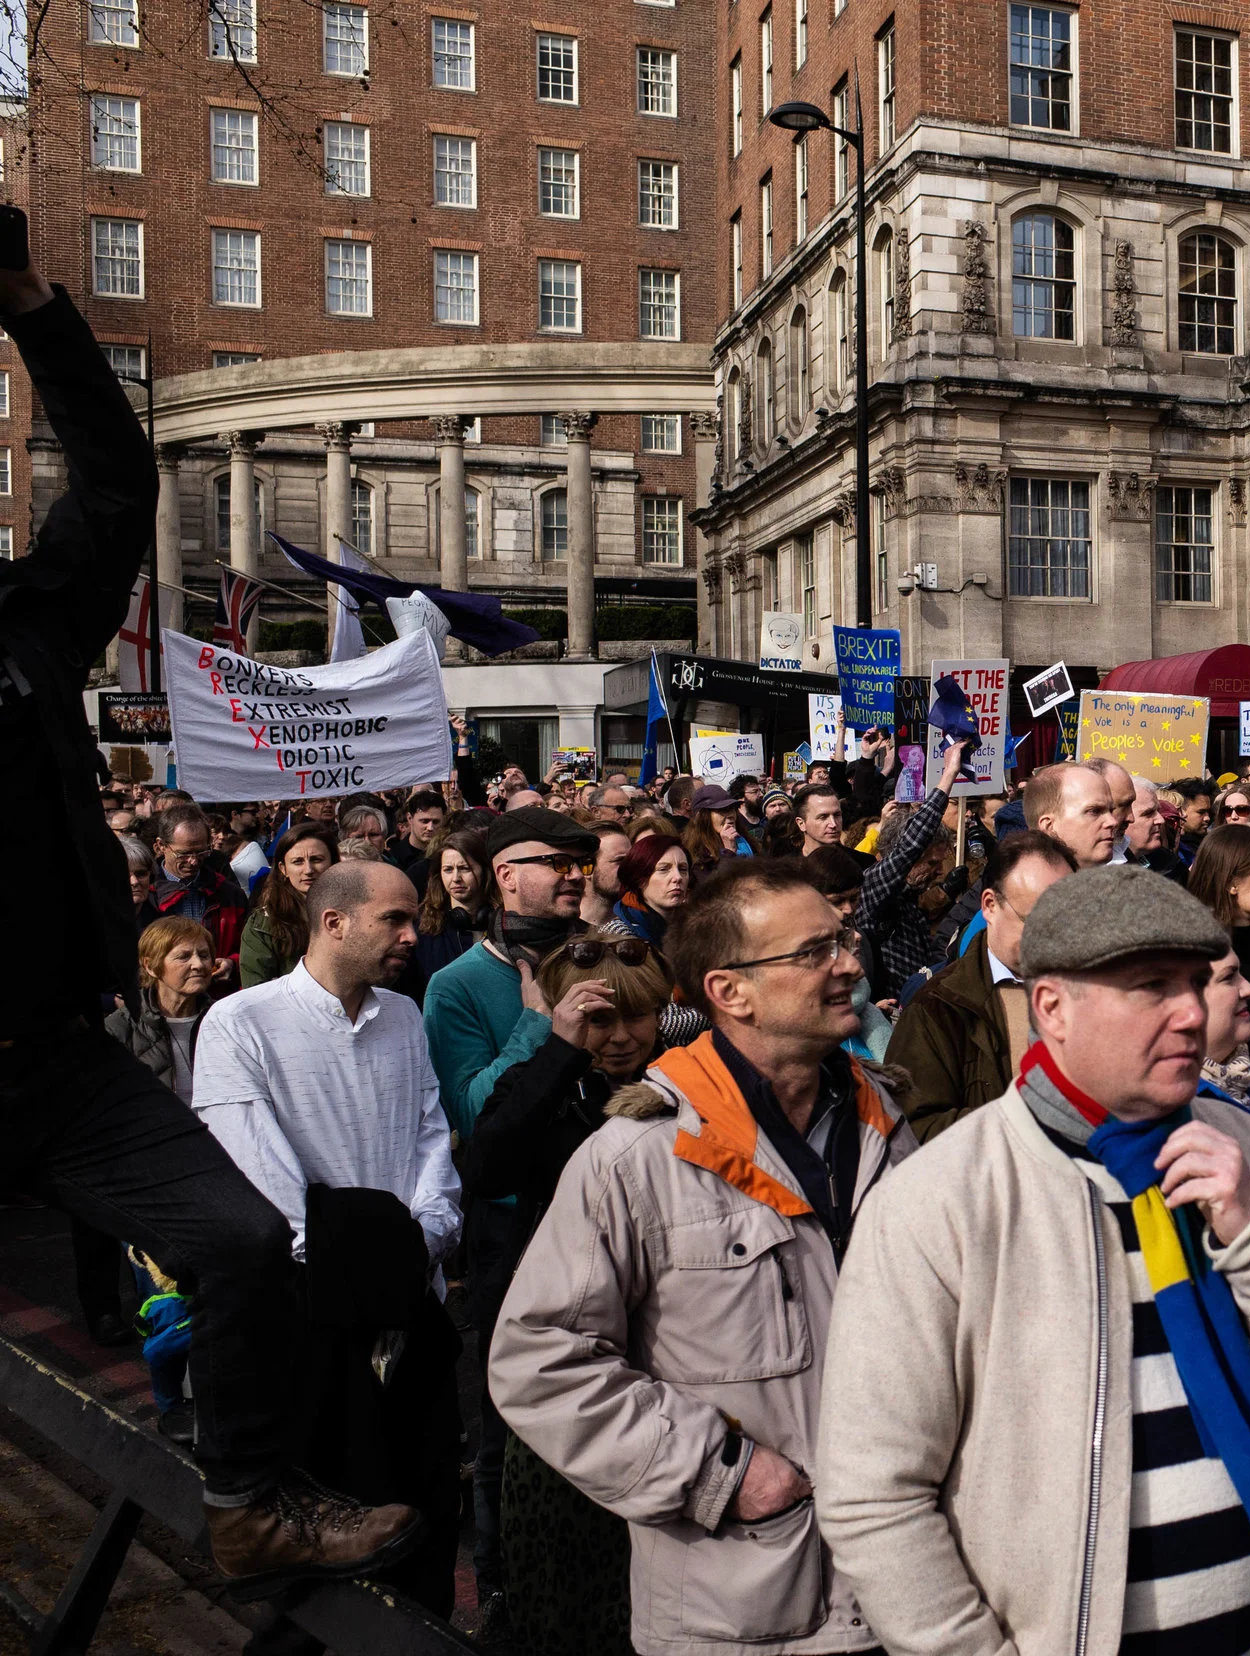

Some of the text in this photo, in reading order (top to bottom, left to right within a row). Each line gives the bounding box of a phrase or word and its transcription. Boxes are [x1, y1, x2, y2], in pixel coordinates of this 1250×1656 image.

[838, 633, 899, 661] BREXIT:
[198, 646, 315, 688] BONKERS
[761, 657, 802, 670] DICTATOR
[210, 671, 318, 697] RECKLESS
[852, 679, 884, 693] PURSUIT
[885, 681, 895, 694] O
[975, 669, 1006, 690] THE
[854, 692, 875, 705] THE
[901, 699, 929, 720] WAN
[1092, 698, 1195, 721] The only meaningful
[230, 697, 353, 723] EXTREMIST
[844, 704, 895, 725] UNDELIVERABL
[248, 716, 389, 749] XENOPHOBIC
[1095, 717, 1148, 728] Vote is a
[1090, 731, 1145, 753] People's
[276, 744, 356, 772] IDIOTIC
[296, 765, 365, 794] TOXIC
